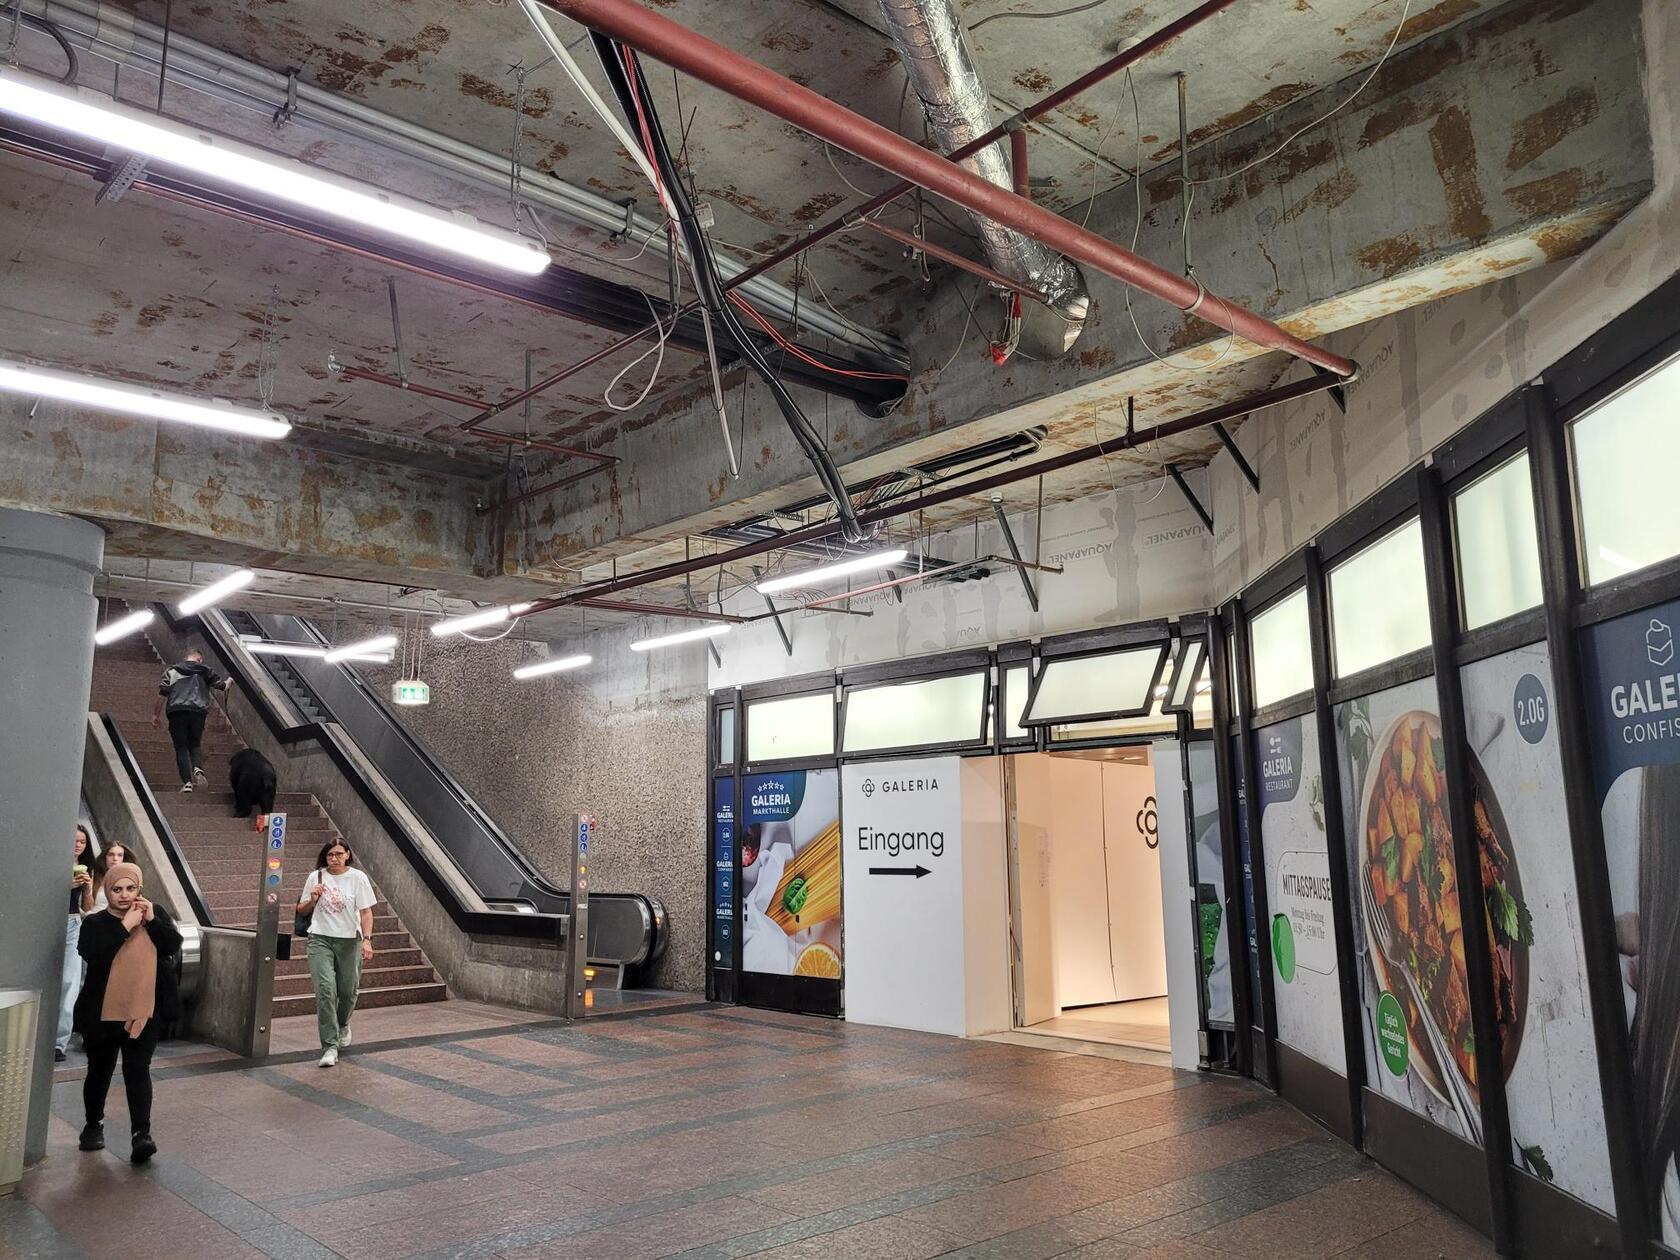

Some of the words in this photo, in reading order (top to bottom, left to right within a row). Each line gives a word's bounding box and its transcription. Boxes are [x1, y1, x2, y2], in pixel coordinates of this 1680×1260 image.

[1611, 672, 1680, 718] GALE
[1517, 696, 1545, 726] 2.0G
[1263, 756, 1293, 778] GALERIA
[882, 778, 939, 793] GALERIA
[1265, 779, 1293, 791] RESTAURANT
[751, 794, 791, 807] GALERIA
[752, 807, 790, 815] MARKTHALLE
[858, 826, 944, 857] Eingang
[1282, 873, 1331, 901] MITTAGSPAUSE
